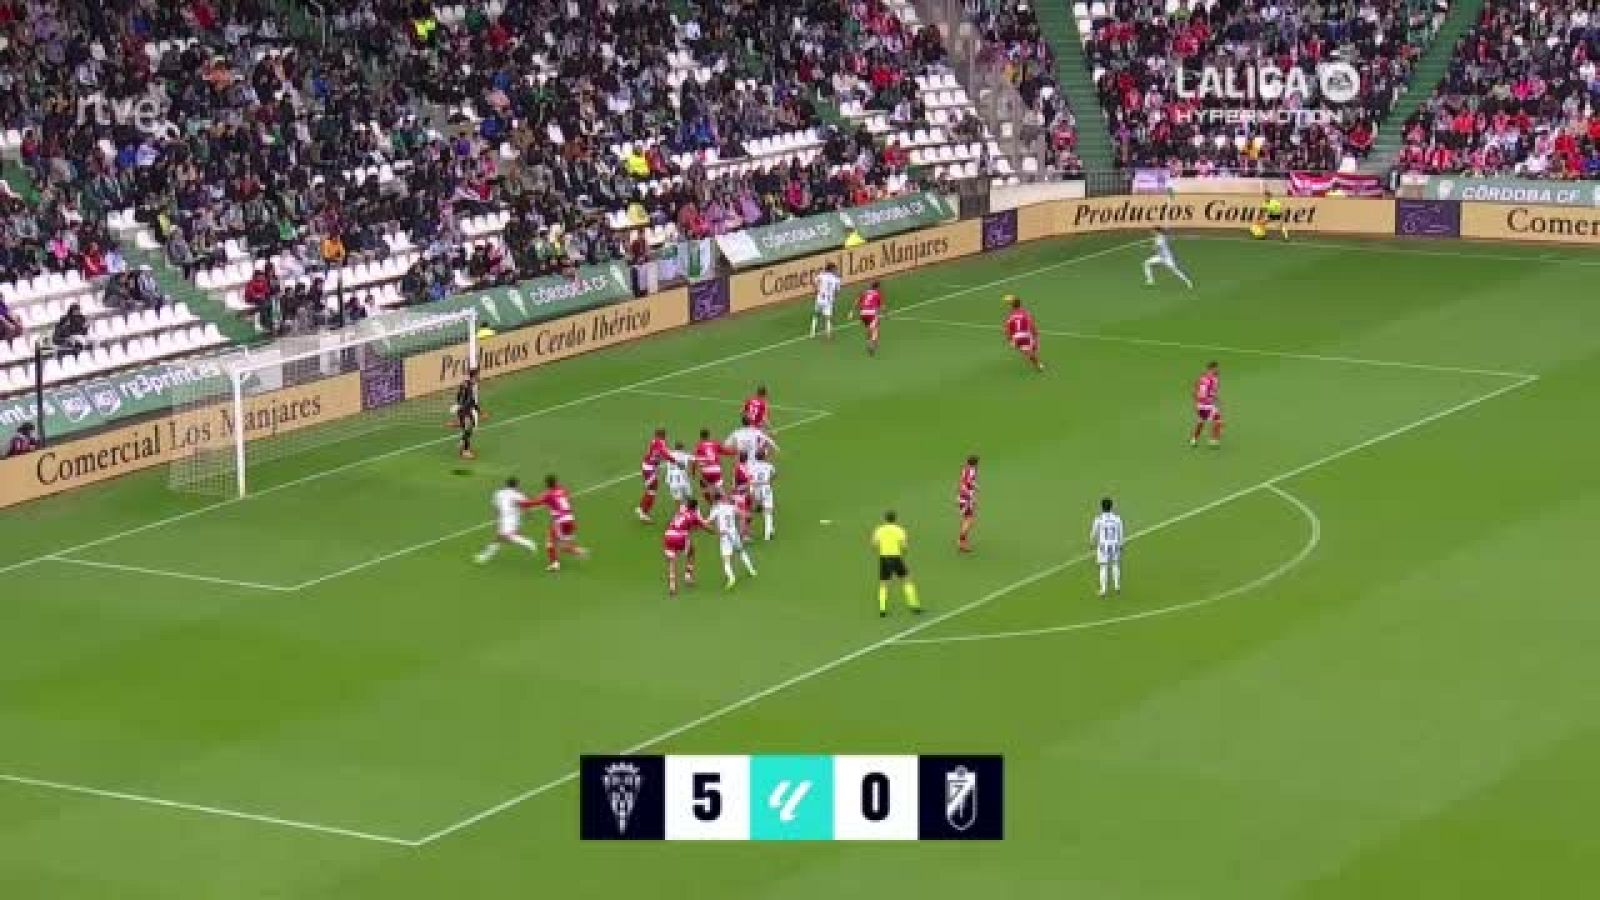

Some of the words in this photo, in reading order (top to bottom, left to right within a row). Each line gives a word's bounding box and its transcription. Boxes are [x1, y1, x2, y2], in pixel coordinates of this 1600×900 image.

[1074, 199, 1194, 225] Productos
[1556, 189, 1580, 203] CF
[849, 249, 876, 276] Los
[880, 235, 949, 268] Manjares
[534, 327, 586, 357] Cerdo
[591, 307, 652, 343] Ibérico
[37, 424, 162, 486] Comercial
[169, 420, 211, 451] Los
